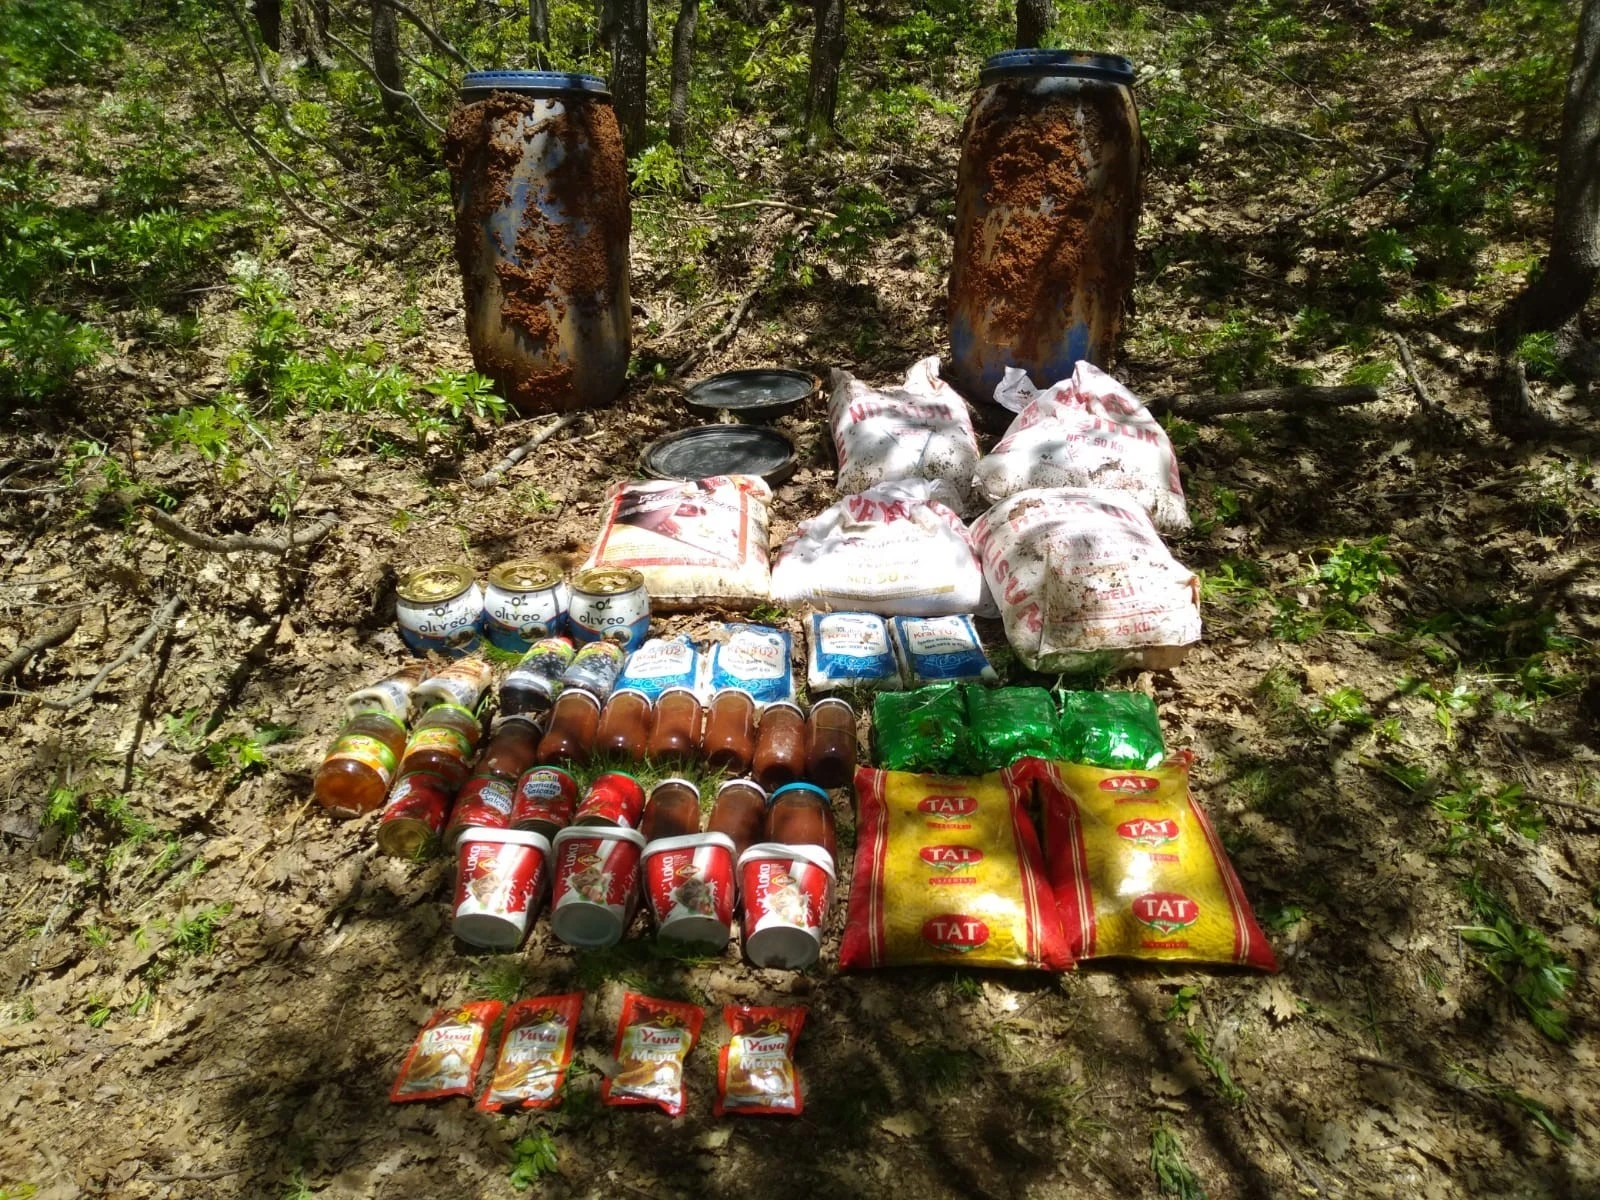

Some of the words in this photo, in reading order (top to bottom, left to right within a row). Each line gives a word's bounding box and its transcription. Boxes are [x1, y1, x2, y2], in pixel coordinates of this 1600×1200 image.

[1094, 437, 1108, 449] 50
[1115, 624, 1130, 637] 25
[1108, 778, 1149, 788] TAT
[926, 798, 968, 812] TAT
[1126, 820, 1173, 836] TAT
[929, 848, 973, 861] TAT
[1142, 899, 1191, 918] TAT
[932, 922, 980, 940] TAT
[434, 1030, 472, 1042] Yuva
[519, 1029, 558, 1043] Yuva
[640, 1028, 681, 1045] Yuva
[748, 1039, 786, 1051] Yuva
[631, 1050, 677, 1064] Maya
[740, 1057, 784, 1070] Maya
